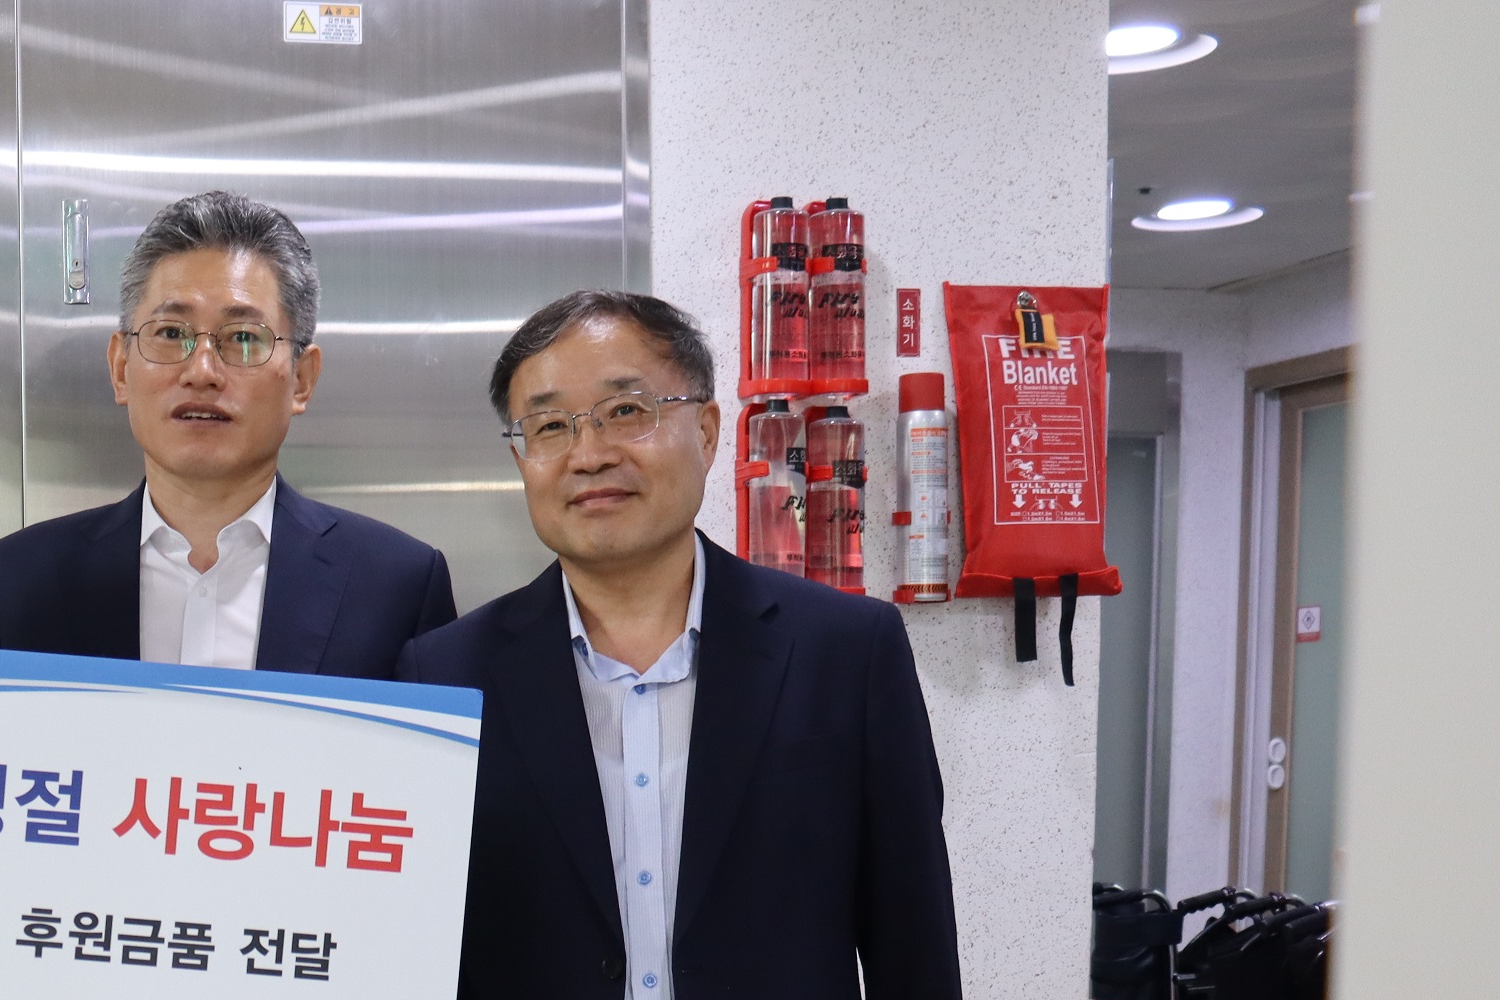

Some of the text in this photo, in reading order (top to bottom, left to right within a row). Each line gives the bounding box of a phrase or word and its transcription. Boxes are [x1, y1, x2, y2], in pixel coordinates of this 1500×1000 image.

[901, 297, 915, 348] 소화기
[1002, 360, 1078, 386] Blanket
[112, 774, 414, 873] 사랑나눔
[15, 906, 217, 974] 후원금품
[238, 927, 338, 983] 전달
